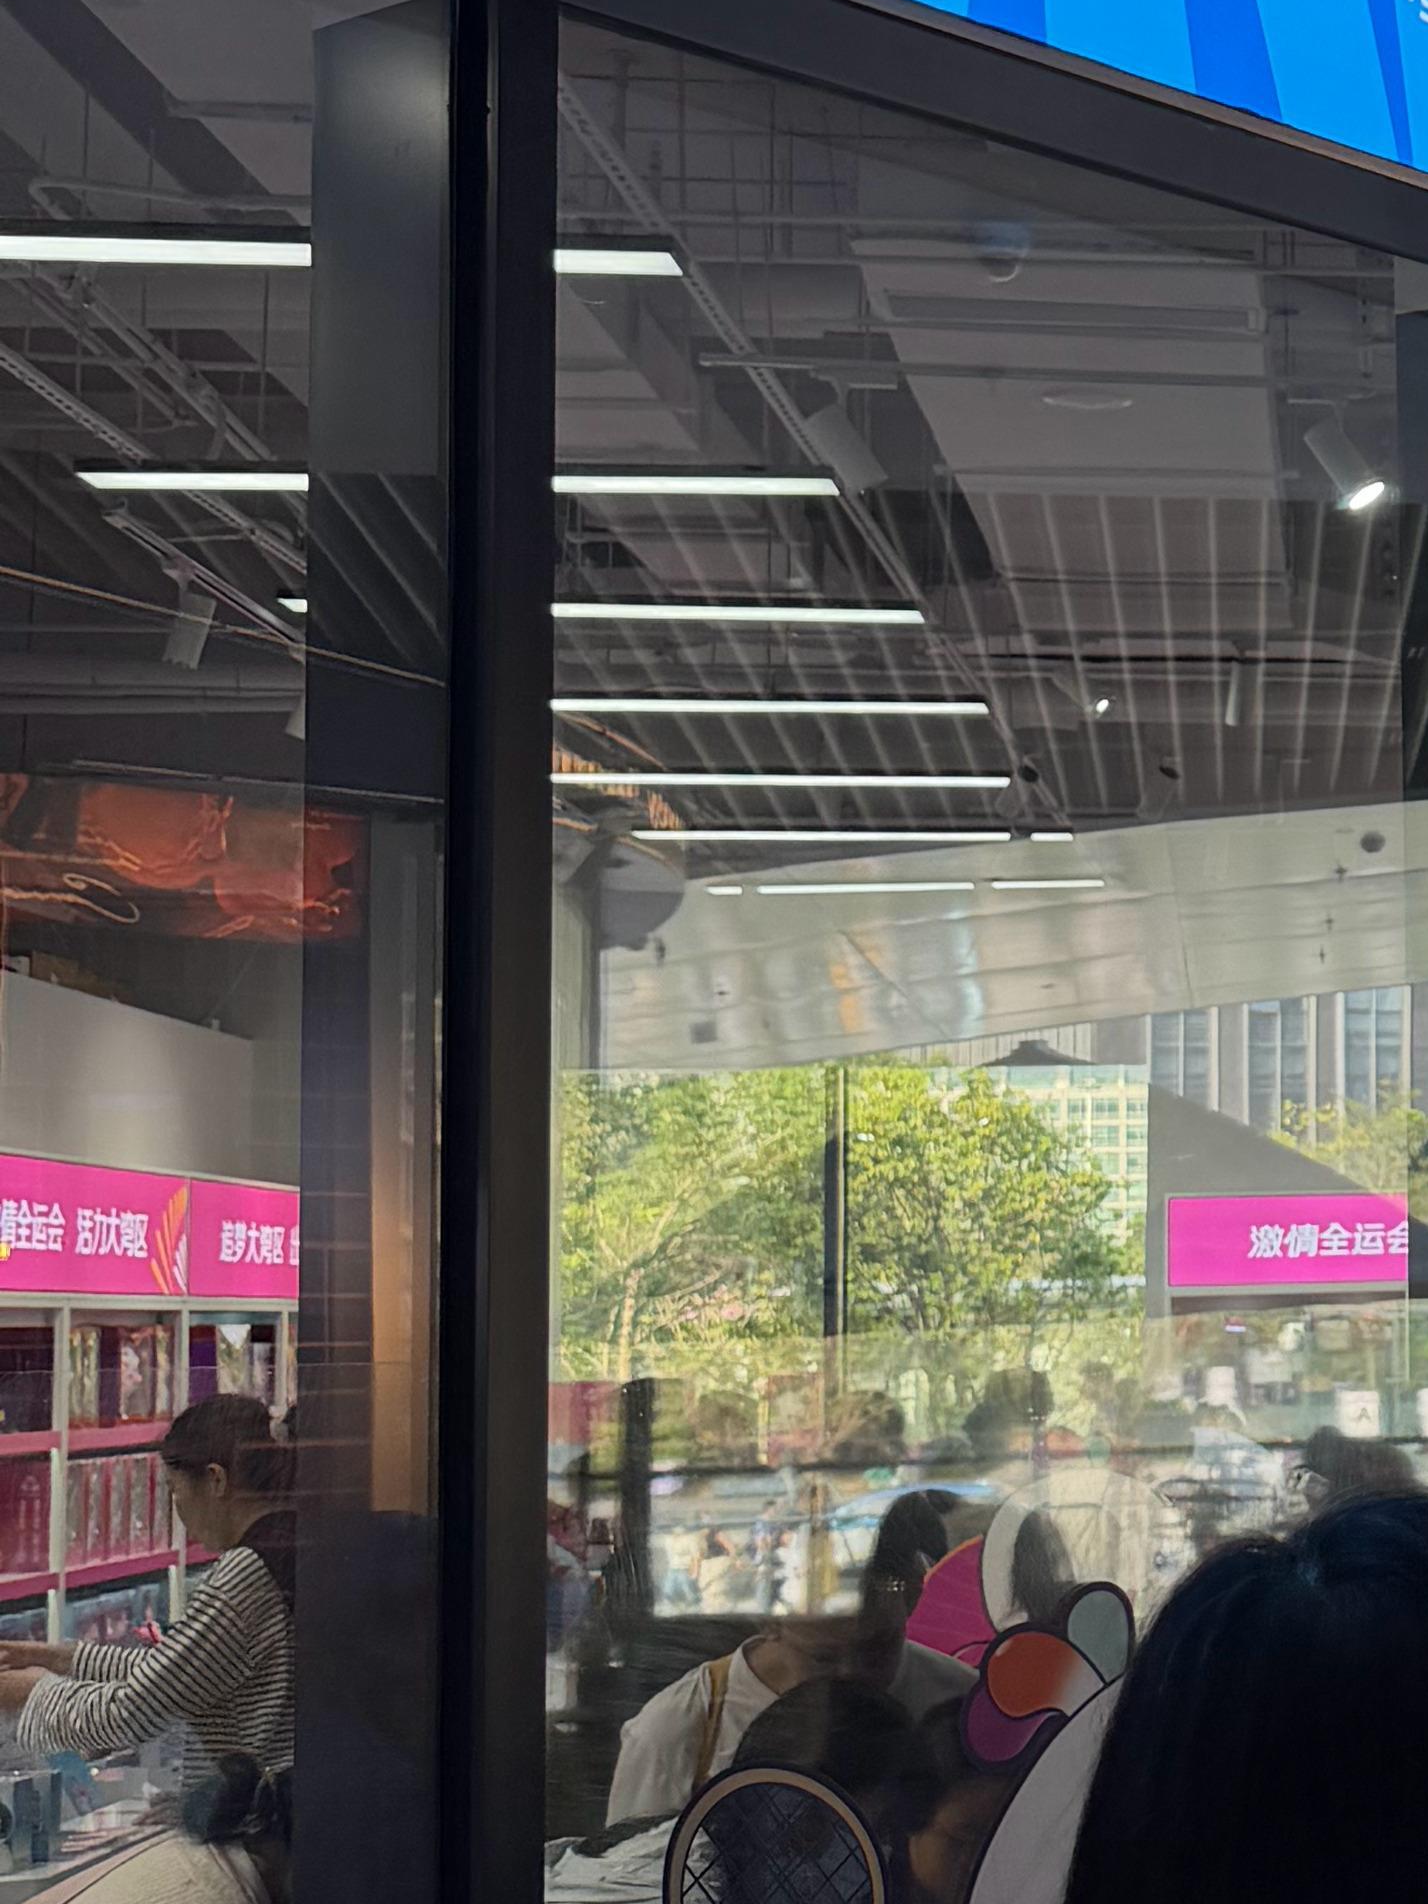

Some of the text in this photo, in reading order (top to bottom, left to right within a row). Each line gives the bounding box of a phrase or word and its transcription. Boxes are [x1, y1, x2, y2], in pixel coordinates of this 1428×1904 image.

[75, 1207, 149, 1258] 活力大湾区
